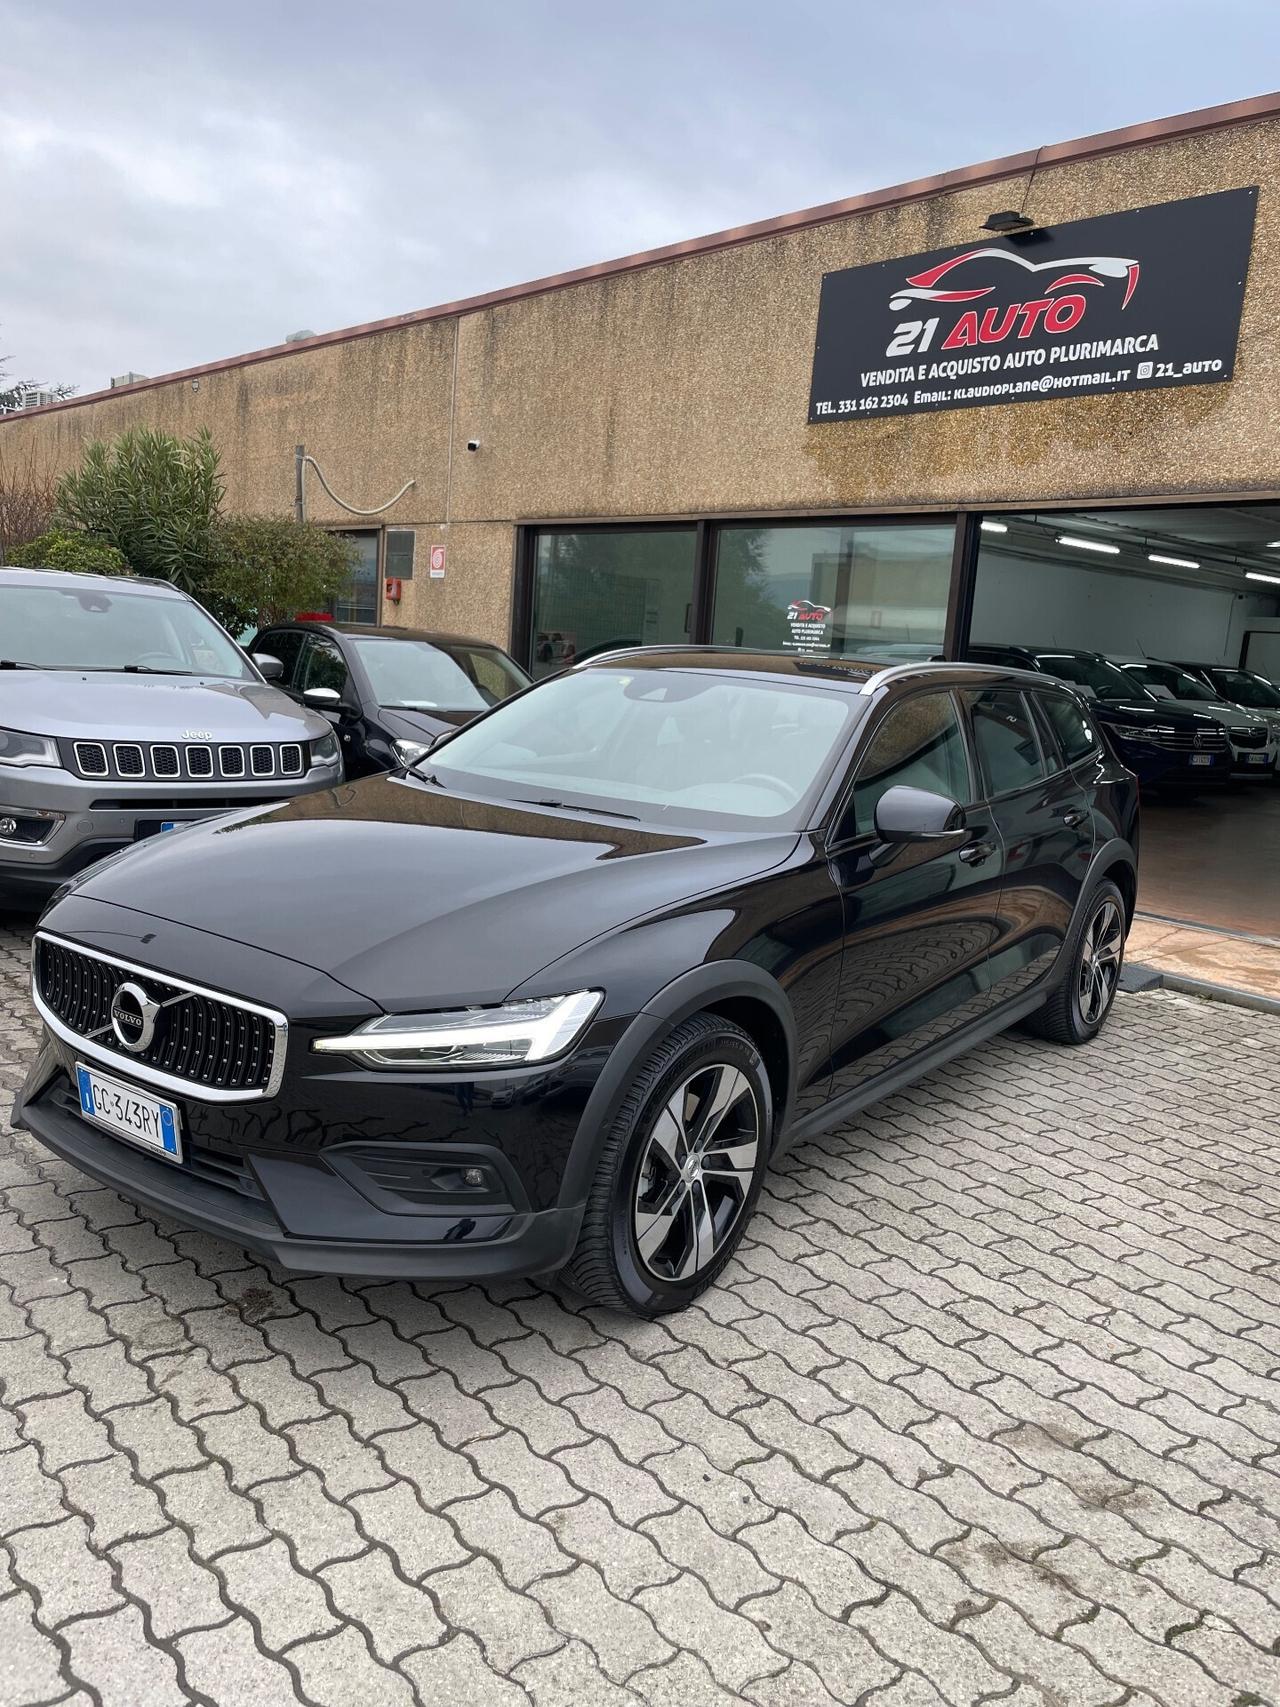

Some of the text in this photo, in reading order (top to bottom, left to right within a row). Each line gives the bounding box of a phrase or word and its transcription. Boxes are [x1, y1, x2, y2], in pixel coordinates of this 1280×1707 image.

[886, 294, 1087, 357] 21 AUTO
[861, 334, 1159, 387] VENDITA E ACQUISTO AUTO PLURIMARCA
[816, 401, 836, 415] TEL.
[838, 399, 857, 413] 331
[859, 396, 878, 411] 162
[881, 393, 909, 408] 2304
[787, 611, 798, 620] 21
[181, 729, 213, 741] Jeep
[113, 1009, 142, 1026] VOLVO
